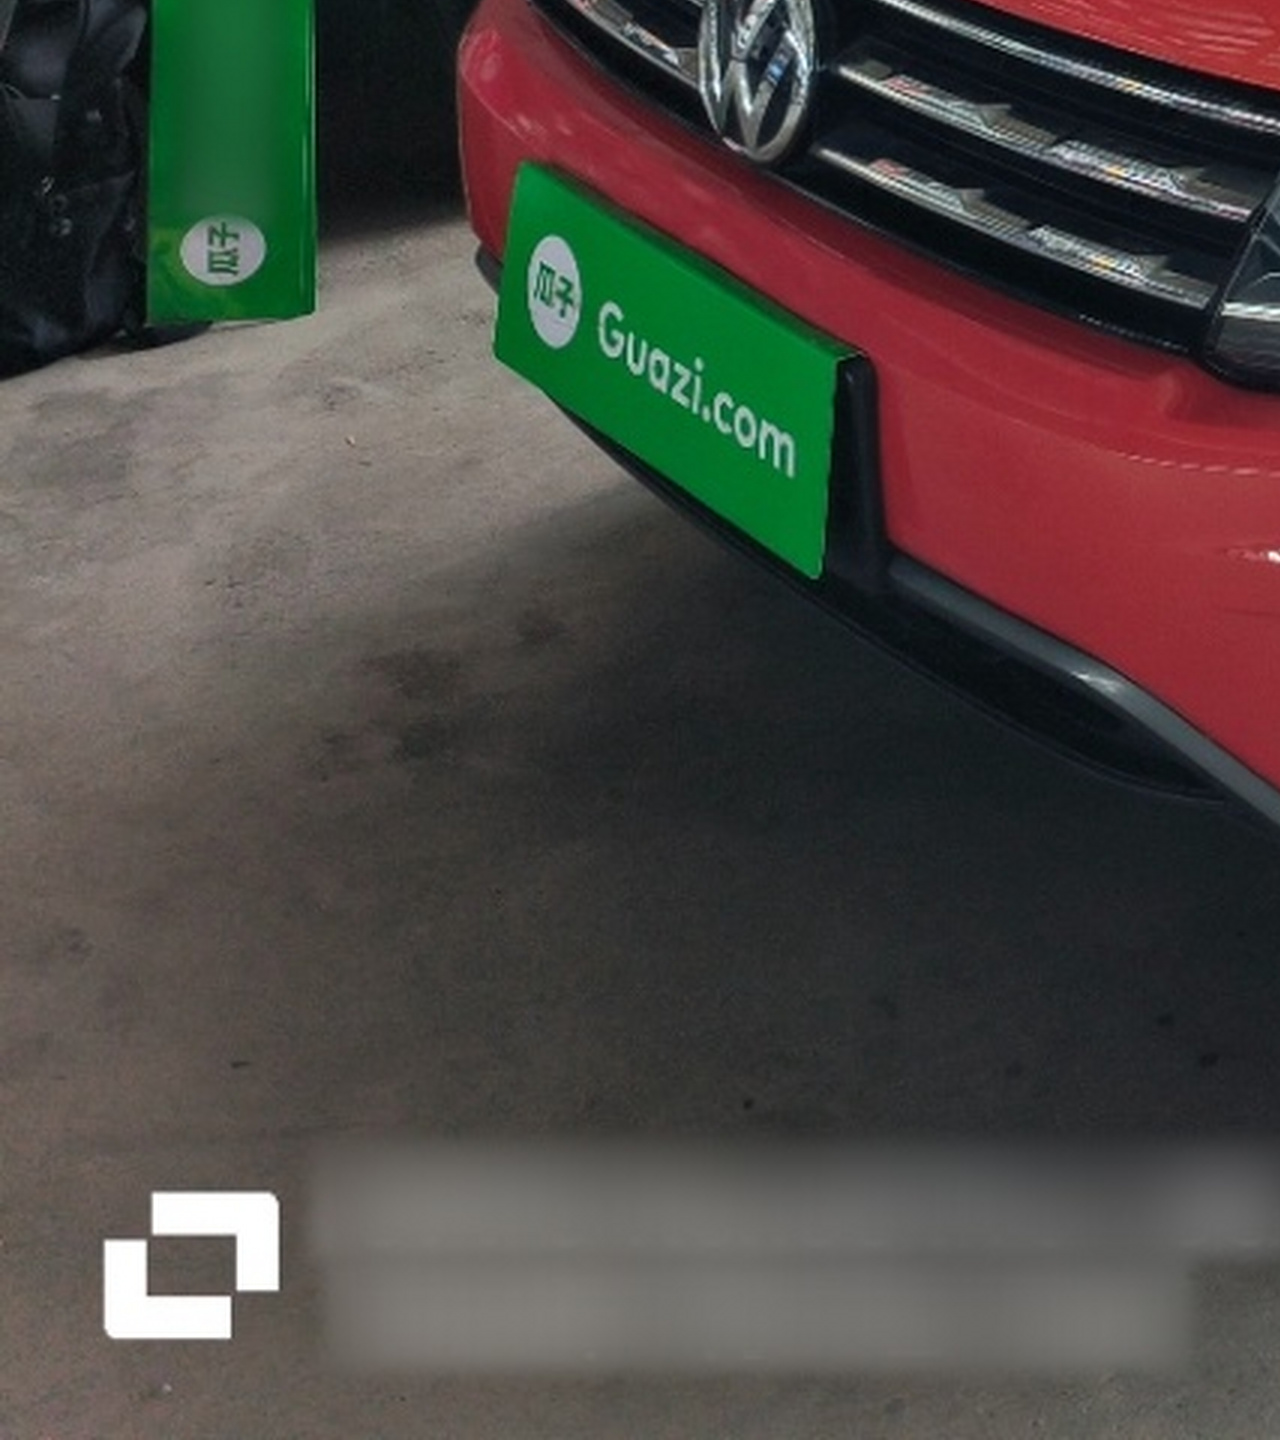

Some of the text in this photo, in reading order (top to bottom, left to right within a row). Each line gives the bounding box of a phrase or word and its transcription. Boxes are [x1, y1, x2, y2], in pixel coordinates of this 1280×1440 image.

[206, 221, 240, 277] 瓜子
[533, 260, 574, 318] 瓜子
[598, 300, 796, 479] Guazi.com
